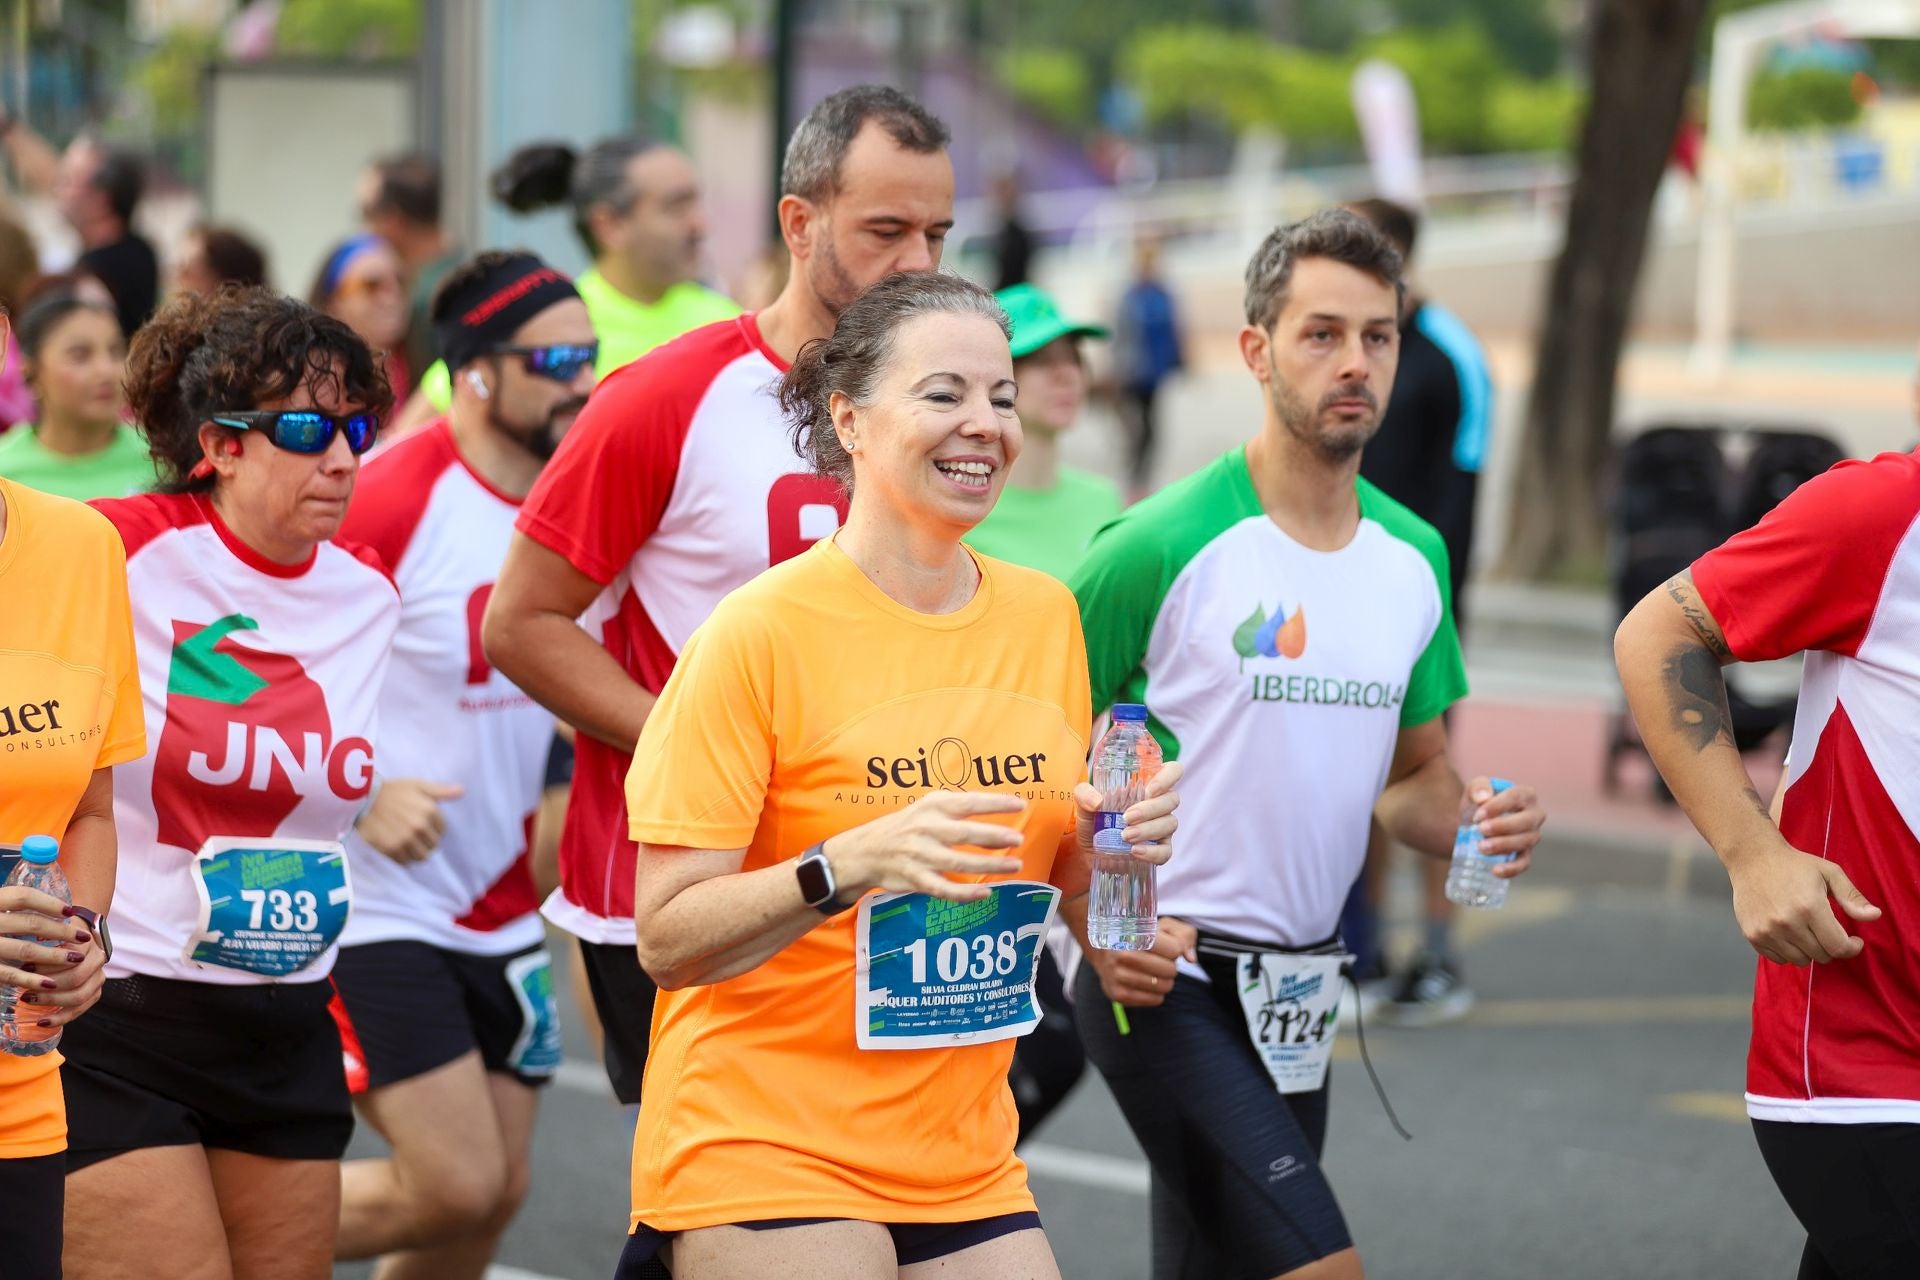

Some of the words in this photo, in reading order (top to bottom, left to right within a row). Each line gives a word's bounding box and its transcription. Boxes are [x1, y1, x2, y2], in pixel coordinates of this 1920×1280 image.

[187, 720, 374, 801] JNG
[866, 736, 1047, 794] seiQuer
[834, 792, 926, 806] AUDITO
[241, 889, 319, 932] 733
[943, 901, 999, 932] EMPRESAS
[904, 930, 1018, 984] 1038
[920, 994, 975, 1007] AUDITORES
[976, 993, 983, 1002] Y
[984, 983, 1030, 1001] CONSULTORES
[921, 983, 945, 994] SILVIA
[947, 981, 980, 993] CELDRAN
[1257, 1008, 1329, 1043] 2124
